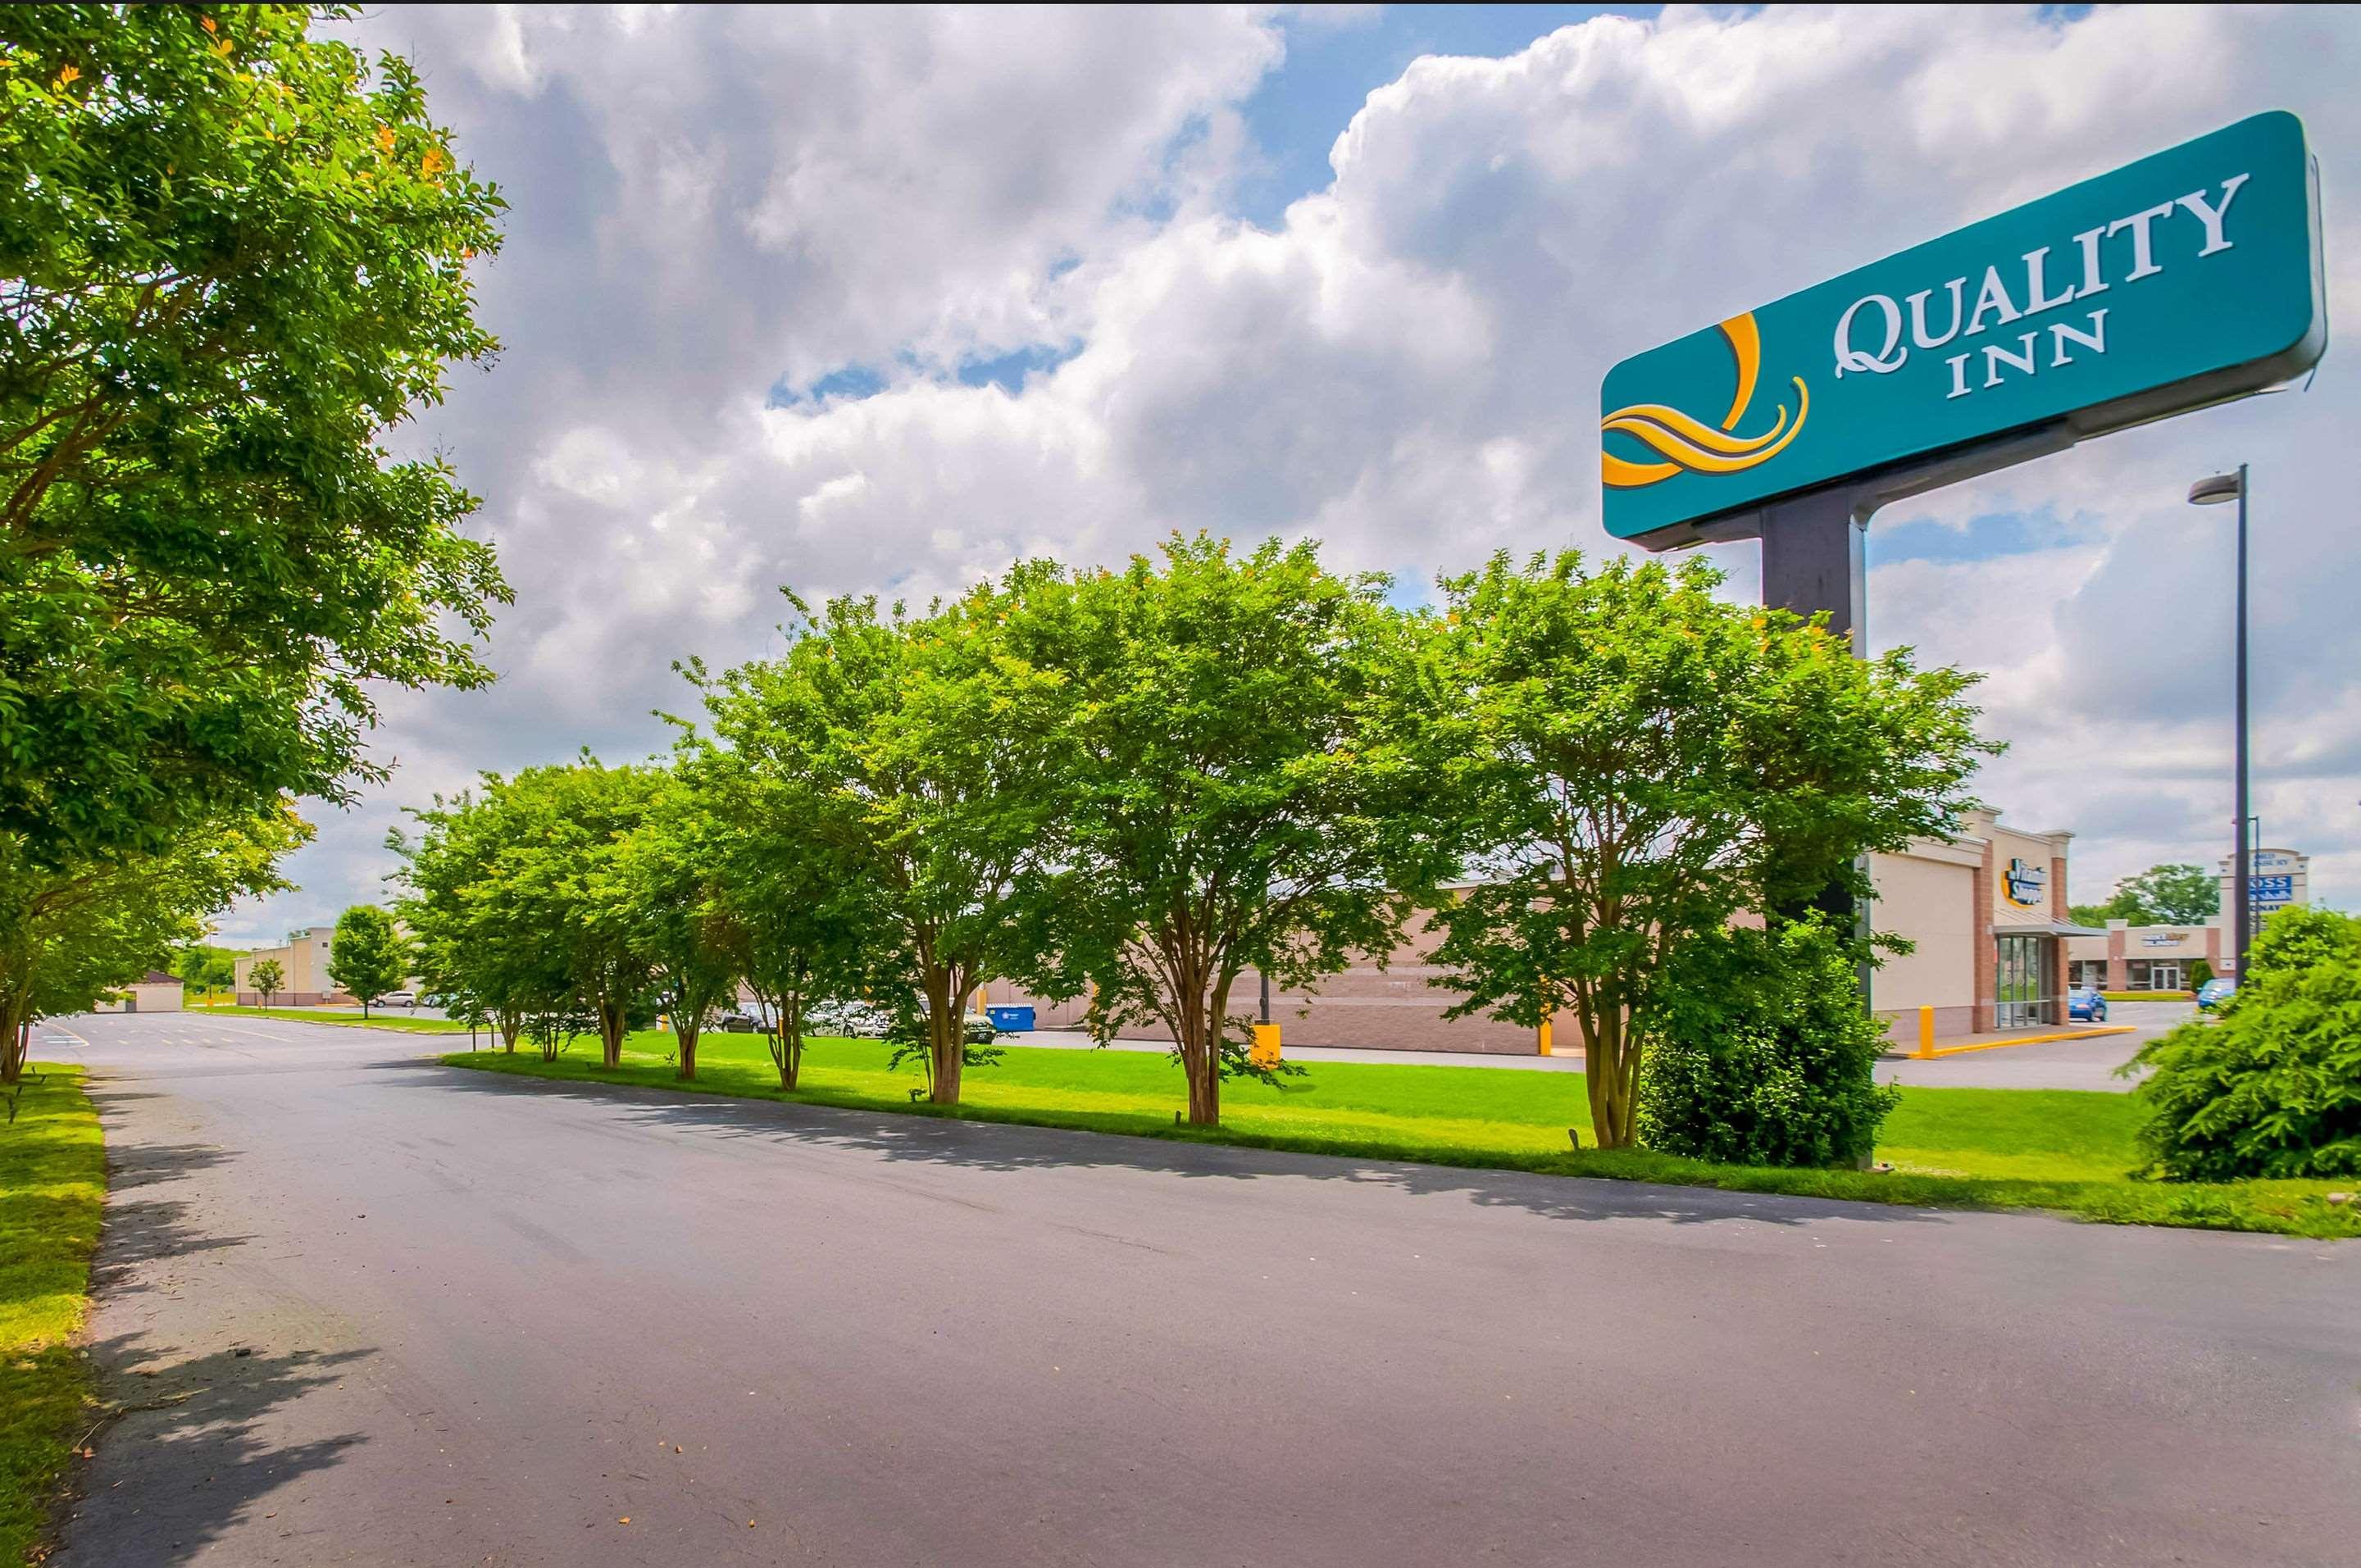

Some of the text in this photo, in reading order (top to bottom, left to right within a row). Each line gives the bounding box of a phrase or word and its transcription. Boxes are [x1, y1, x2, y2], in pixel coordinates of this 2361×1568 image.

[1834, 172, 2250, 380] QUALITY
[1946, 310, 2109, 399] INN
[2249, 877, 2287, 888] OSS
